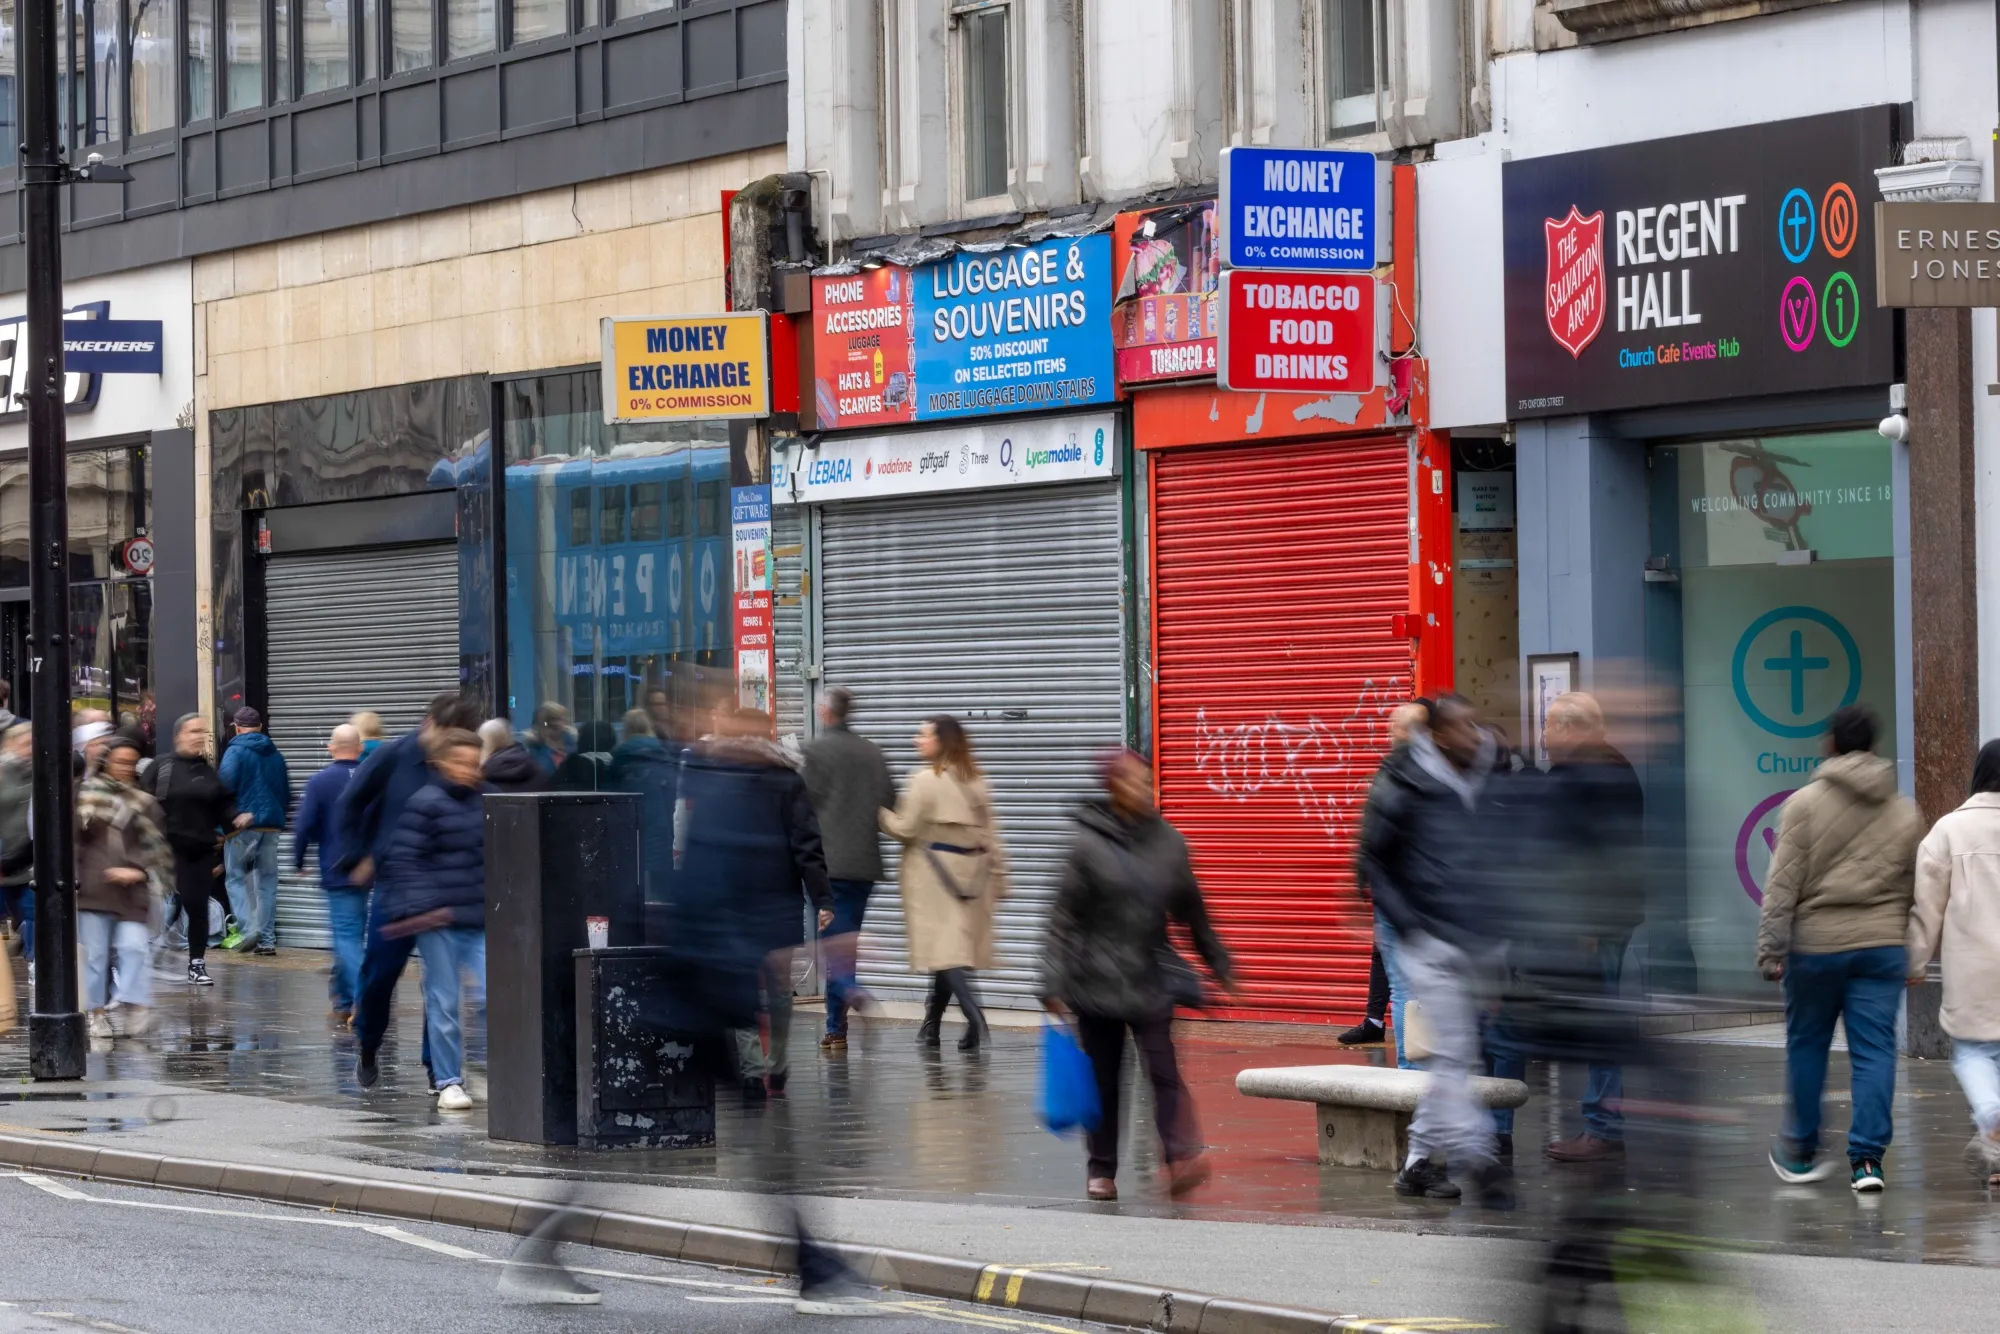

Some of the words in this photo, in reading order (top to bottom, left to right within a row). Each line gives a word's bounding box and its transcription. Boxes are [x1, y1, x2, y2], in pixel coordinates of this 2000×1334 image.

[1263, 160, 1344, 193] MONEY
[1244, 205, 1363, 240] EXCHANGE
[1616, 193, 1747, 266] REGENT
[1245, 246, 1266, 259] 0%
[1270, 246, 1365, 260] COMMISSION
[1557, 226, 1579, 268] THE
[932, 249, 1058, 299] LUGGAGE
[1066, 245, 1086, 280] &
[1550, 233, 1599, 319] SALVATION
[825, 280, 864, 305] PHONE
[1242, 283, 1360, 312] TOBACCO
[1618, 269, 1702, 333] HALL
[826, 306, 902, 335] ACCESSORIES
[933, 290, 1087, 343] SOUVENIRS
[1567, 276, 1597, 338] ARMY
[647, 325, 727, 353] MONEY
[848, 334, 880, 350] LUGGAGE
[1269, 319, 1334, 345] FOOD
[64, 341, 155, 352] SKECHERS
[970, 343, 993, 362] 50%
[995, 338, 1049, 360] DISCOUNT
[1150, 344, 1202, 375] TOBACCO
[1206, 346, 1216, 368] &
[1619, 345, 1656, 368] Church
[1657, 344, 1680, 364] Cafe
[1682, 340, 1716, 361] Events
[1718, 336, 1740, 358] Hub
[629, 362, 750, 390] EXCHANGE
[838, 372, 862, 391] HATS
[864, 371, 871, 388] &
[954, 368, 972, 384] ON
[974, 362, 1031, 383] SELLECTED
[1033, 357, 1066, 377] ITEMS
[1255, 354, 1348, 380] DRINKS
[630, 398, 652, 411] 0%
[655, 394, 752, 409] COMMISSION
[839, 395, 882, 416] SCARVES
[929, 391, 961, 413] MORE
[963, 386, 1017, 410] LUGGAGE
[1018, 381, 1054, 405] DOWN
[1056, 377, 1096, 402] STAIRS
[1519, 400, 1528, 409] 275
[1528, 398, 1546, 408] OXFORD
[1547, 396, 1564, 406] STREET
[808, 459, 852, 485] LEBARA
[877, 458, 912, 474] vodafone
[919, 451, 950, 477] giffgaff
[971, 451, 989, 466] Three
[1026, 441, 1082, 469] Lycamobile
[733, 504, 769, 520] GIFTWARE
[1692, 494, 1758, 514] WELCOMING
[1763, 488, 1832, 509] COMMUNITY
[1837, 486, 1873, 504] SINCE
[736, 528, 768, 542] SOUVENIRS
[739, 599, 752, 609] MOBILE
[752, 598, 768, 608] PHONES
[743, 616, 758, 627] REPAIRS
[741, 634, 767, 645] ACCESSORIES
